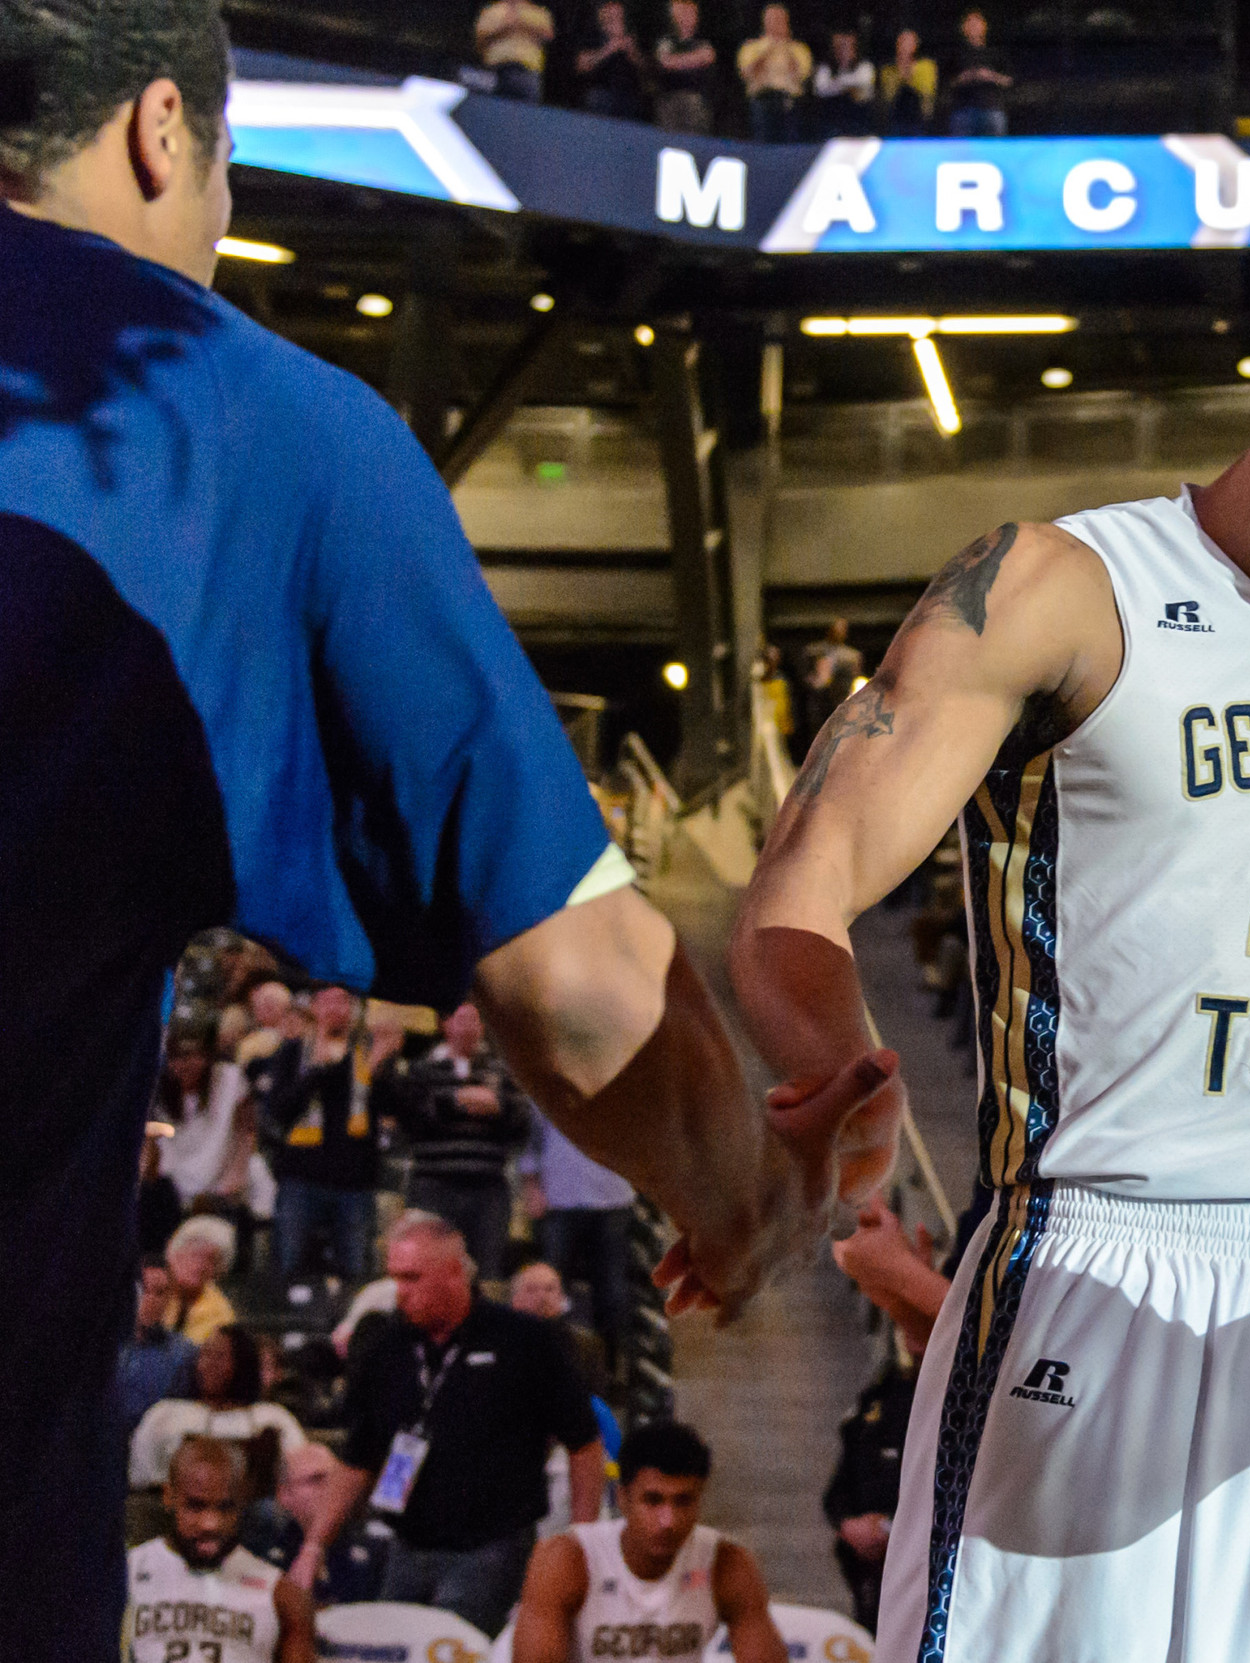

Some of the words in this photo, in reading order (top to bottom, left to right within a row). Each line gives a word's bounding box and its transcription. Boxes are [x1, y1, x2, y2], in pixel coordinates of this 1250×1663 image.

[1156, 620, 1216, 633] RUSSELL
[1009, 1386, 1076, 1408] RUSSELL
[134, 1602, 255, 1645] GEORGIA
